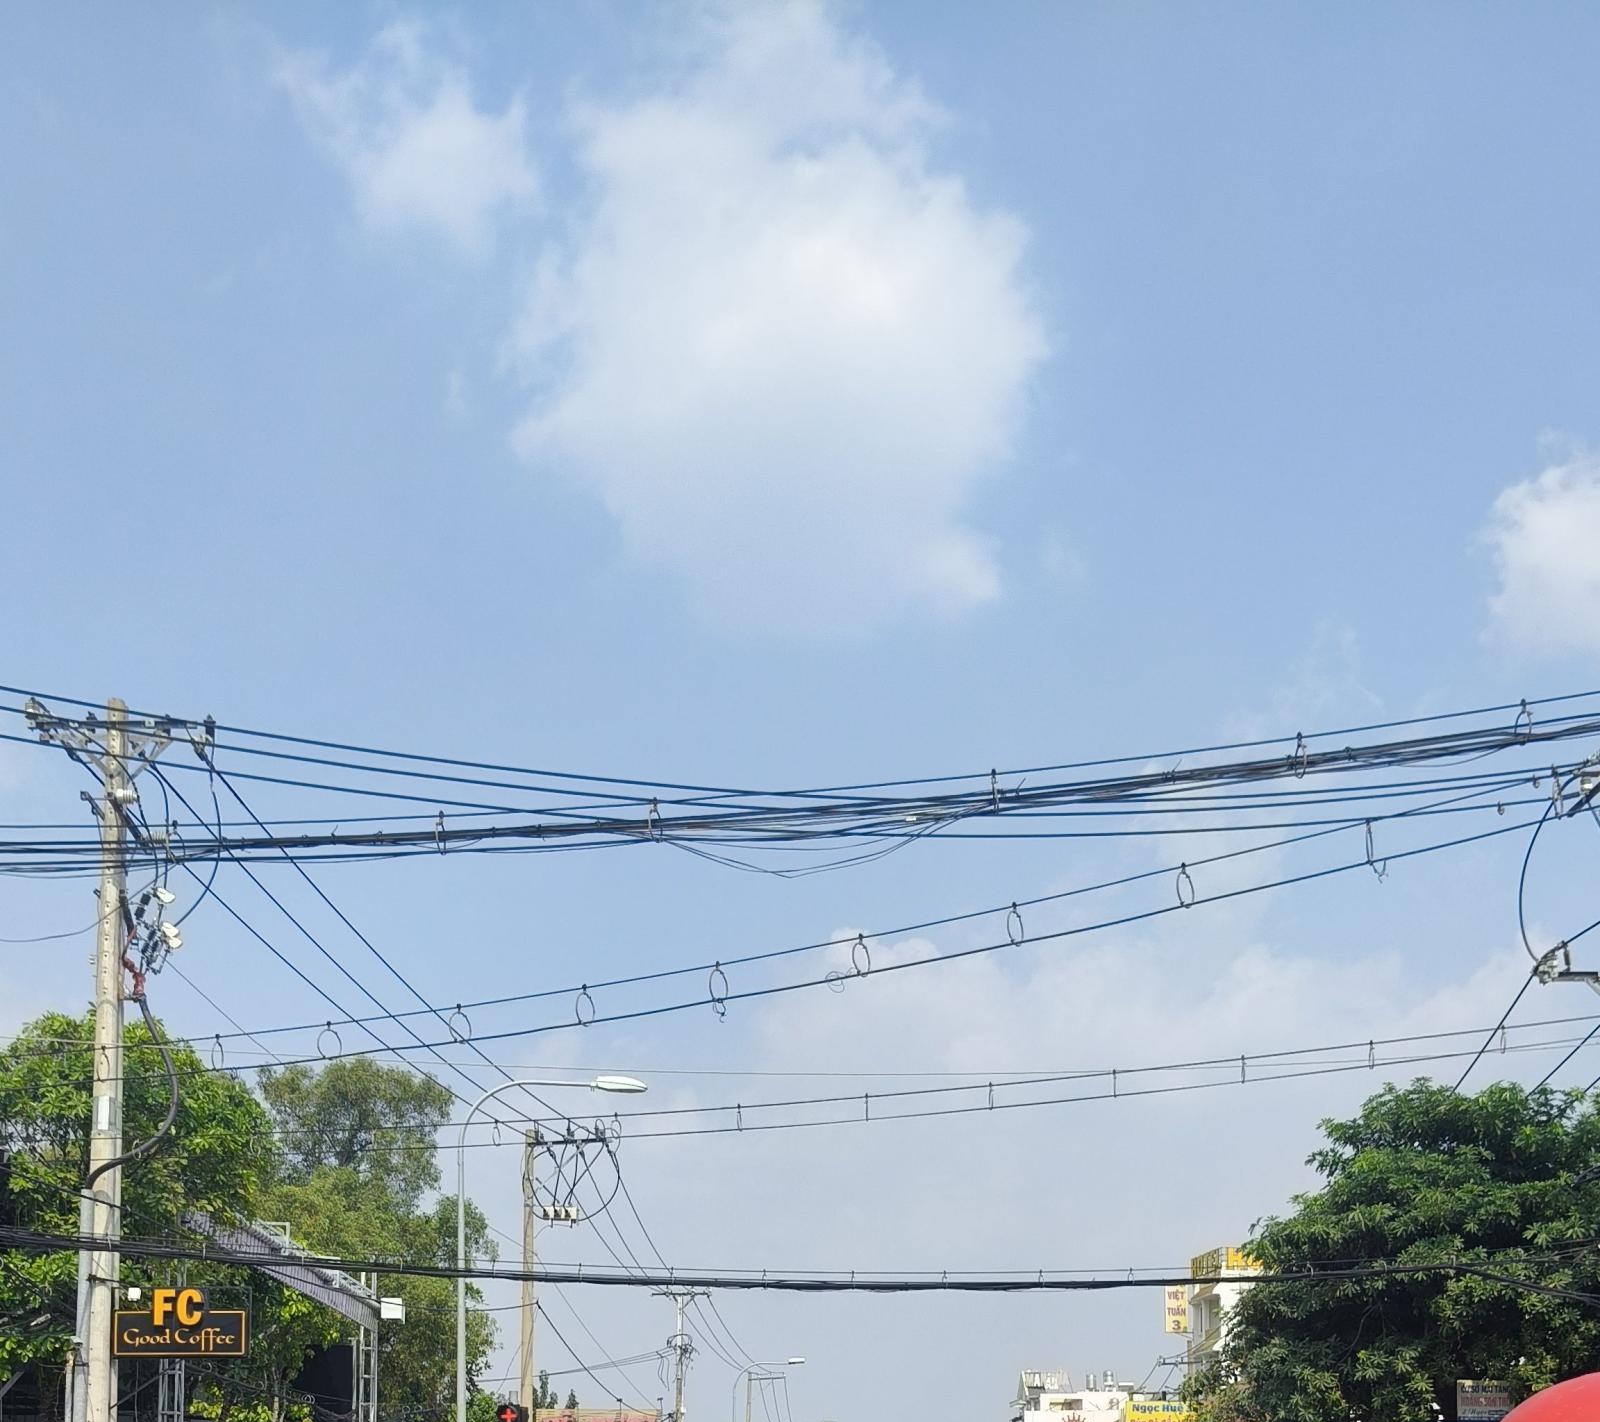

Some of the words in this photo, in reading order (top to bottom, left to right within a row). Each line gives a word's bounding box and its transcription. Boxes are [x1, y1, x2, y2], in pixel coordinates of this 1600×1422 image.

[1167, 1288, 1184, 1301] VIỆT
[153, 1289, 203, 1326] FC
[1172, 1320, 1181, 1331] 3
[123, 1328, 171, 1348] Good
[174, 1328, 235, 1352] Coffee
[1132, 1404, 1160, 1413] Ngọc
